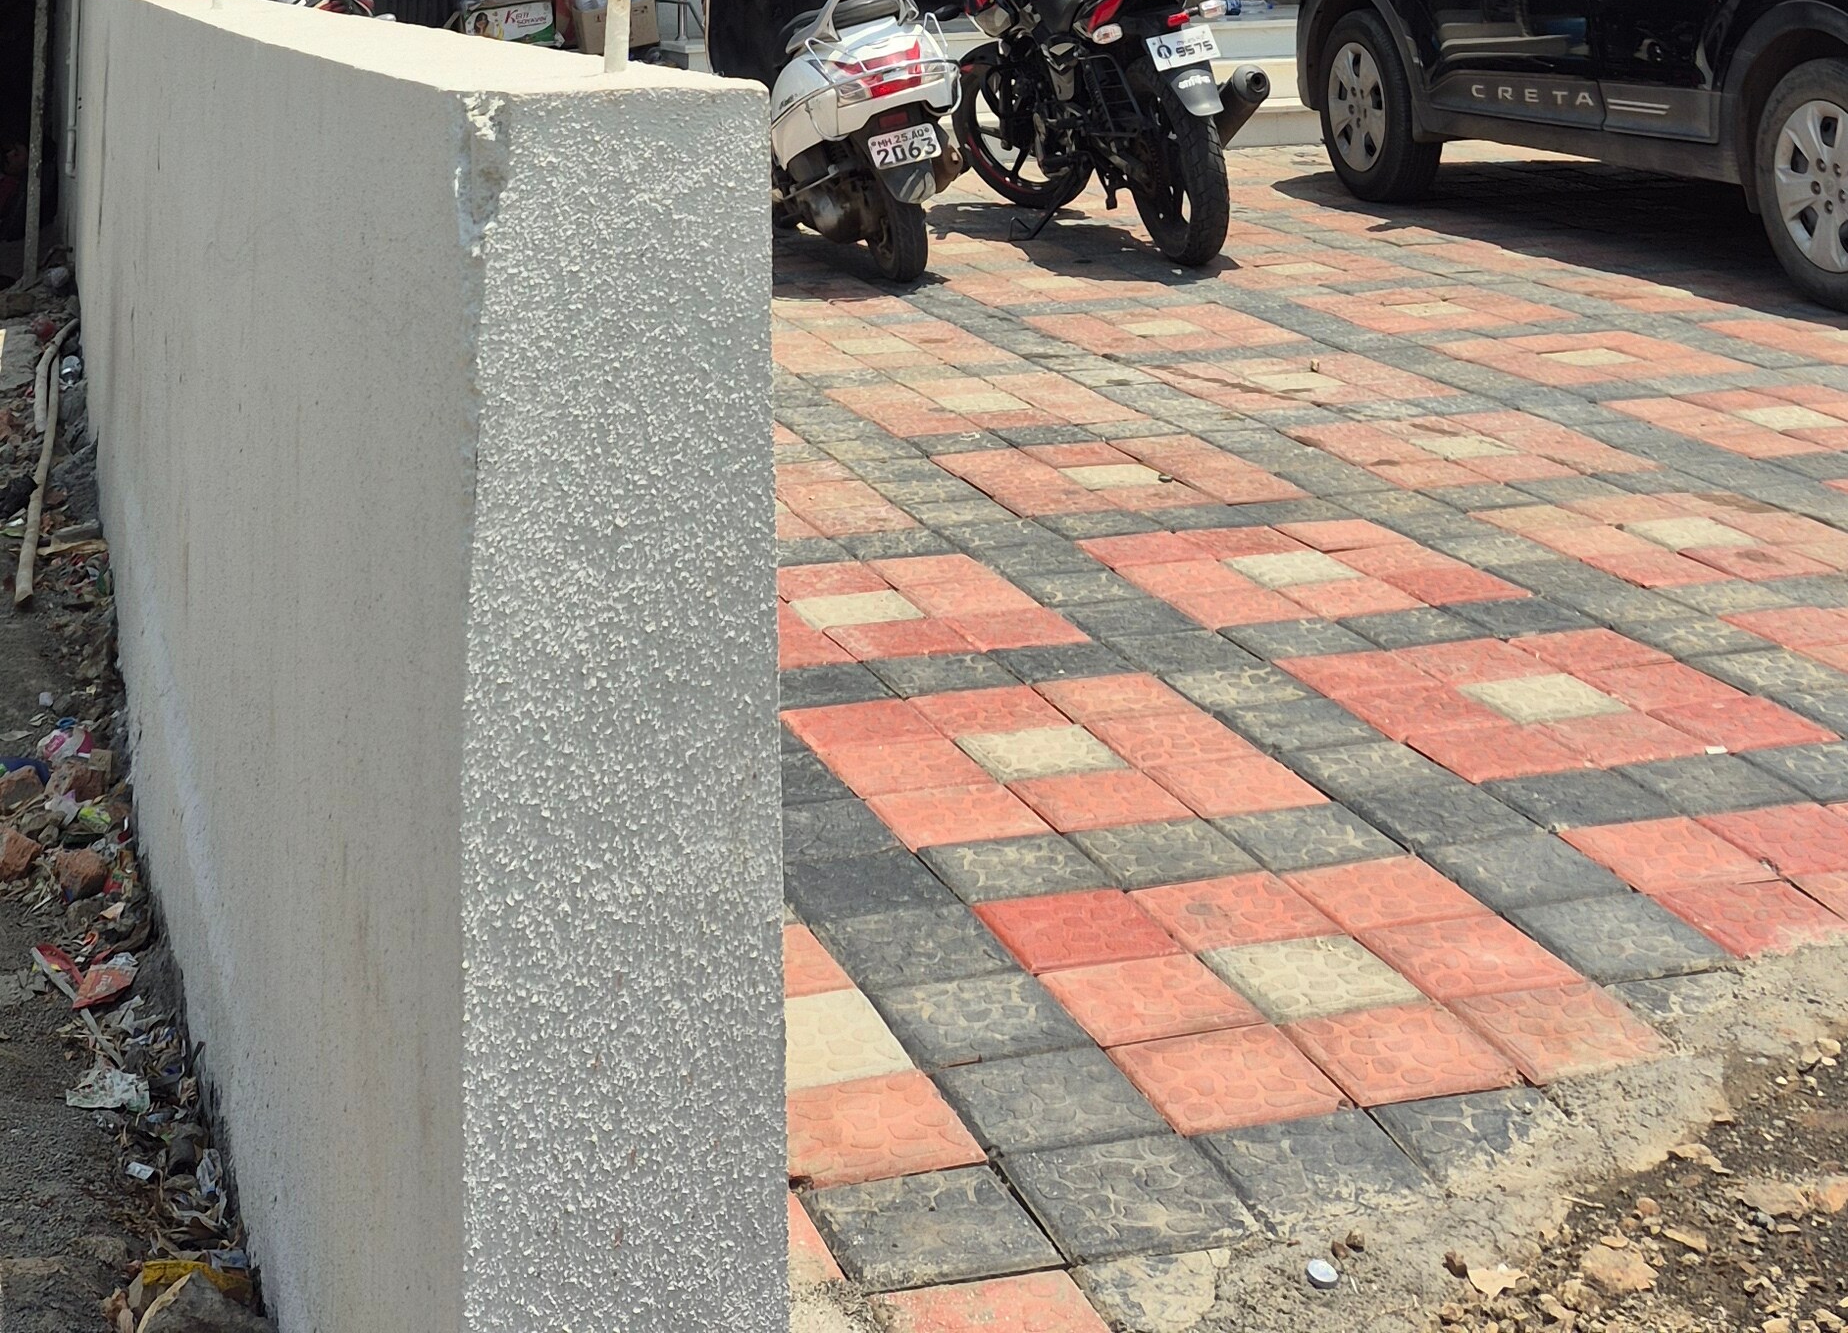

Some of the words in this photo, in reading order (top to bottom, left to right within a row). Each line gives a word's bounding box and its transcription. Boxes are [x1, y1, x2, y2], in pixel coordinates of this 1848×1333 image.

[1175, 40, 1214, 58] 9575
[1471, 84, 1594, 106] CRETA
[876, 136, 937, 166] 2063
